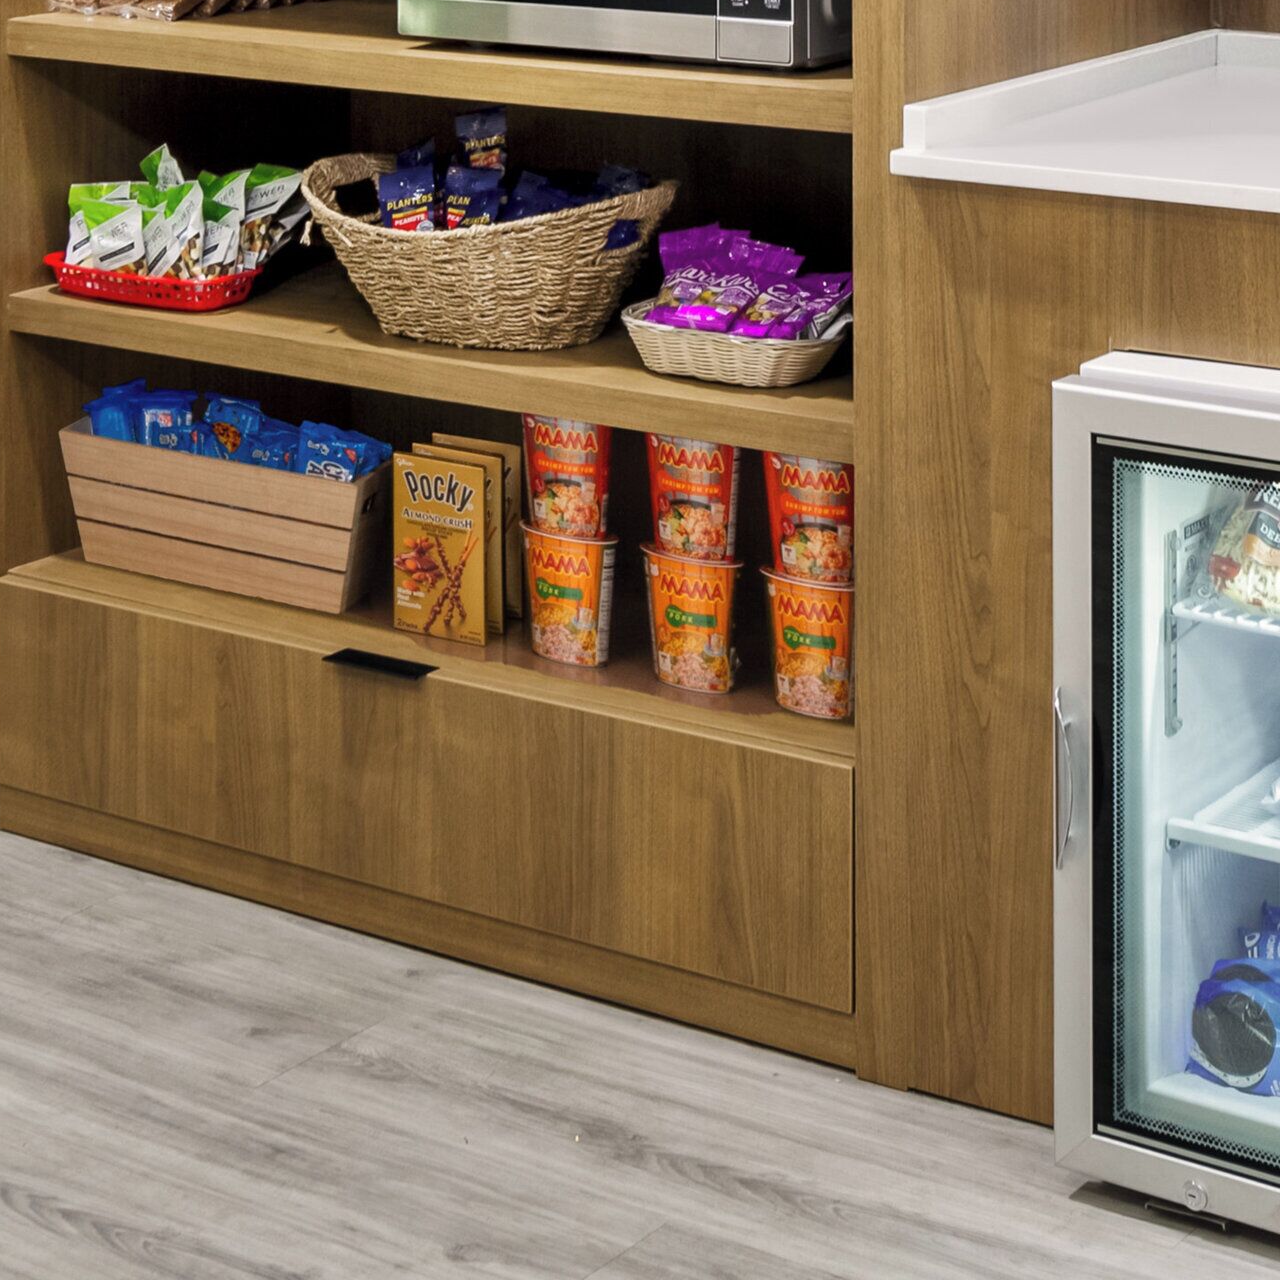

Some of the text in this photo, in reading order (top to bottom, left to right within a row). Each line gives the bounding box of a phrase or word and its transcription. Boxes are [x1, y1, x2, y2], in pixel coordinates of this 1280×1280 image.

[386, 193, 434, 211] PLANTERS
[446, 195, 471, 205] PLAN
[534, 422, 599, 454] MAMA
[658, 441, 725, 474] MAMA
[781, 463, 851, 495] MAMA
[402, 507, 441, 523] ALMOND
[443, 516, 473, 529] CRUSH
[529, 546, 593, 577] MAMA
[537, 582, 560, 596] PORK
[660, 572, 725, 603] MAMA
[669, 611, 694, 625] PORK
[776, 593, 845, 625] MAMA
[787, 631, 812, 646] PORK
